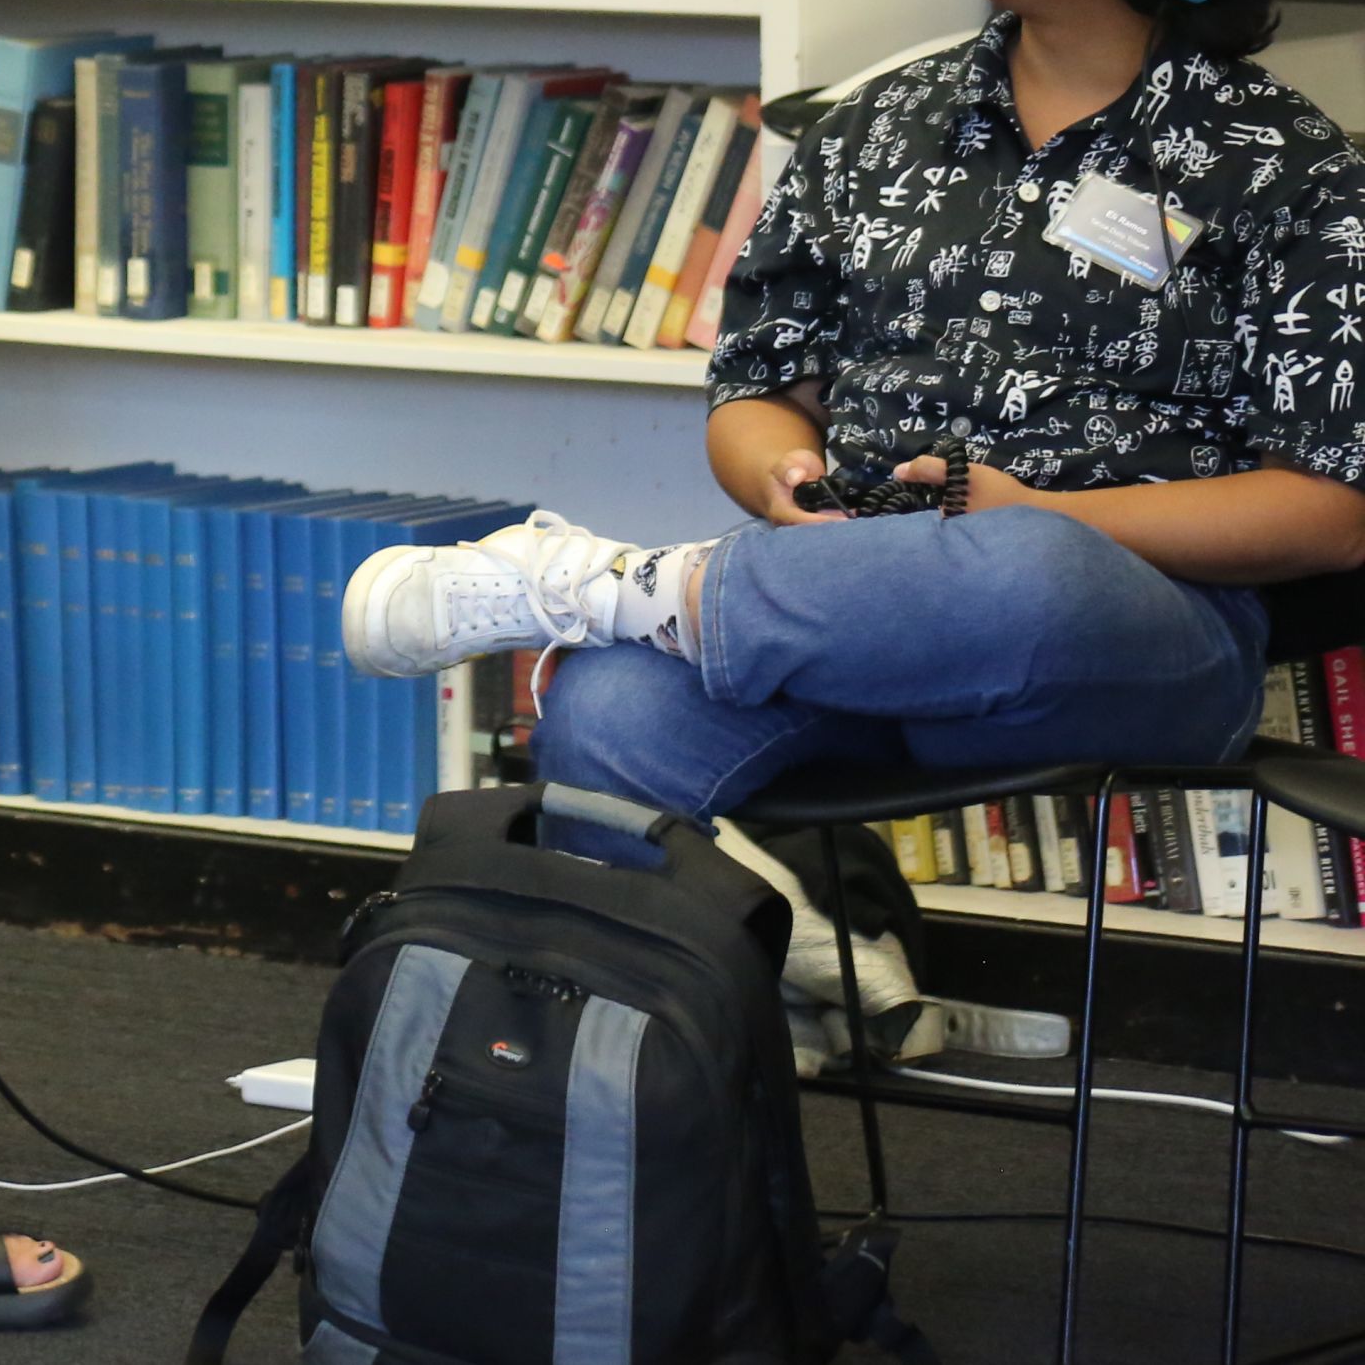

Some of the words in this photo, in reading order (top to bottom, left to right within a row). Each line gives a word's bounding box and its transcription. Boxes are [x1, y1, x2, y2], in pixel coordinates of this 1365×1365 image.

[1106, 210, 1118, 223] Eli
[1118, 215, 1148, 235] Ramos
[1294, 662, 1308, 685] PAY
[1332, 658, 1349, 705] GAIL
[1297, 689, 1312, 713] ANY
[1301, 719, 1316, 747] PRIC
[1339, 714, 1354, 755] SHE
[1132, 808, 1150, 834] Facts
[1194, 790, 1214, 856] nderthals
[1316, 823, 1331, 852] MES
[1320, 858, 1336, 895] RISEN
